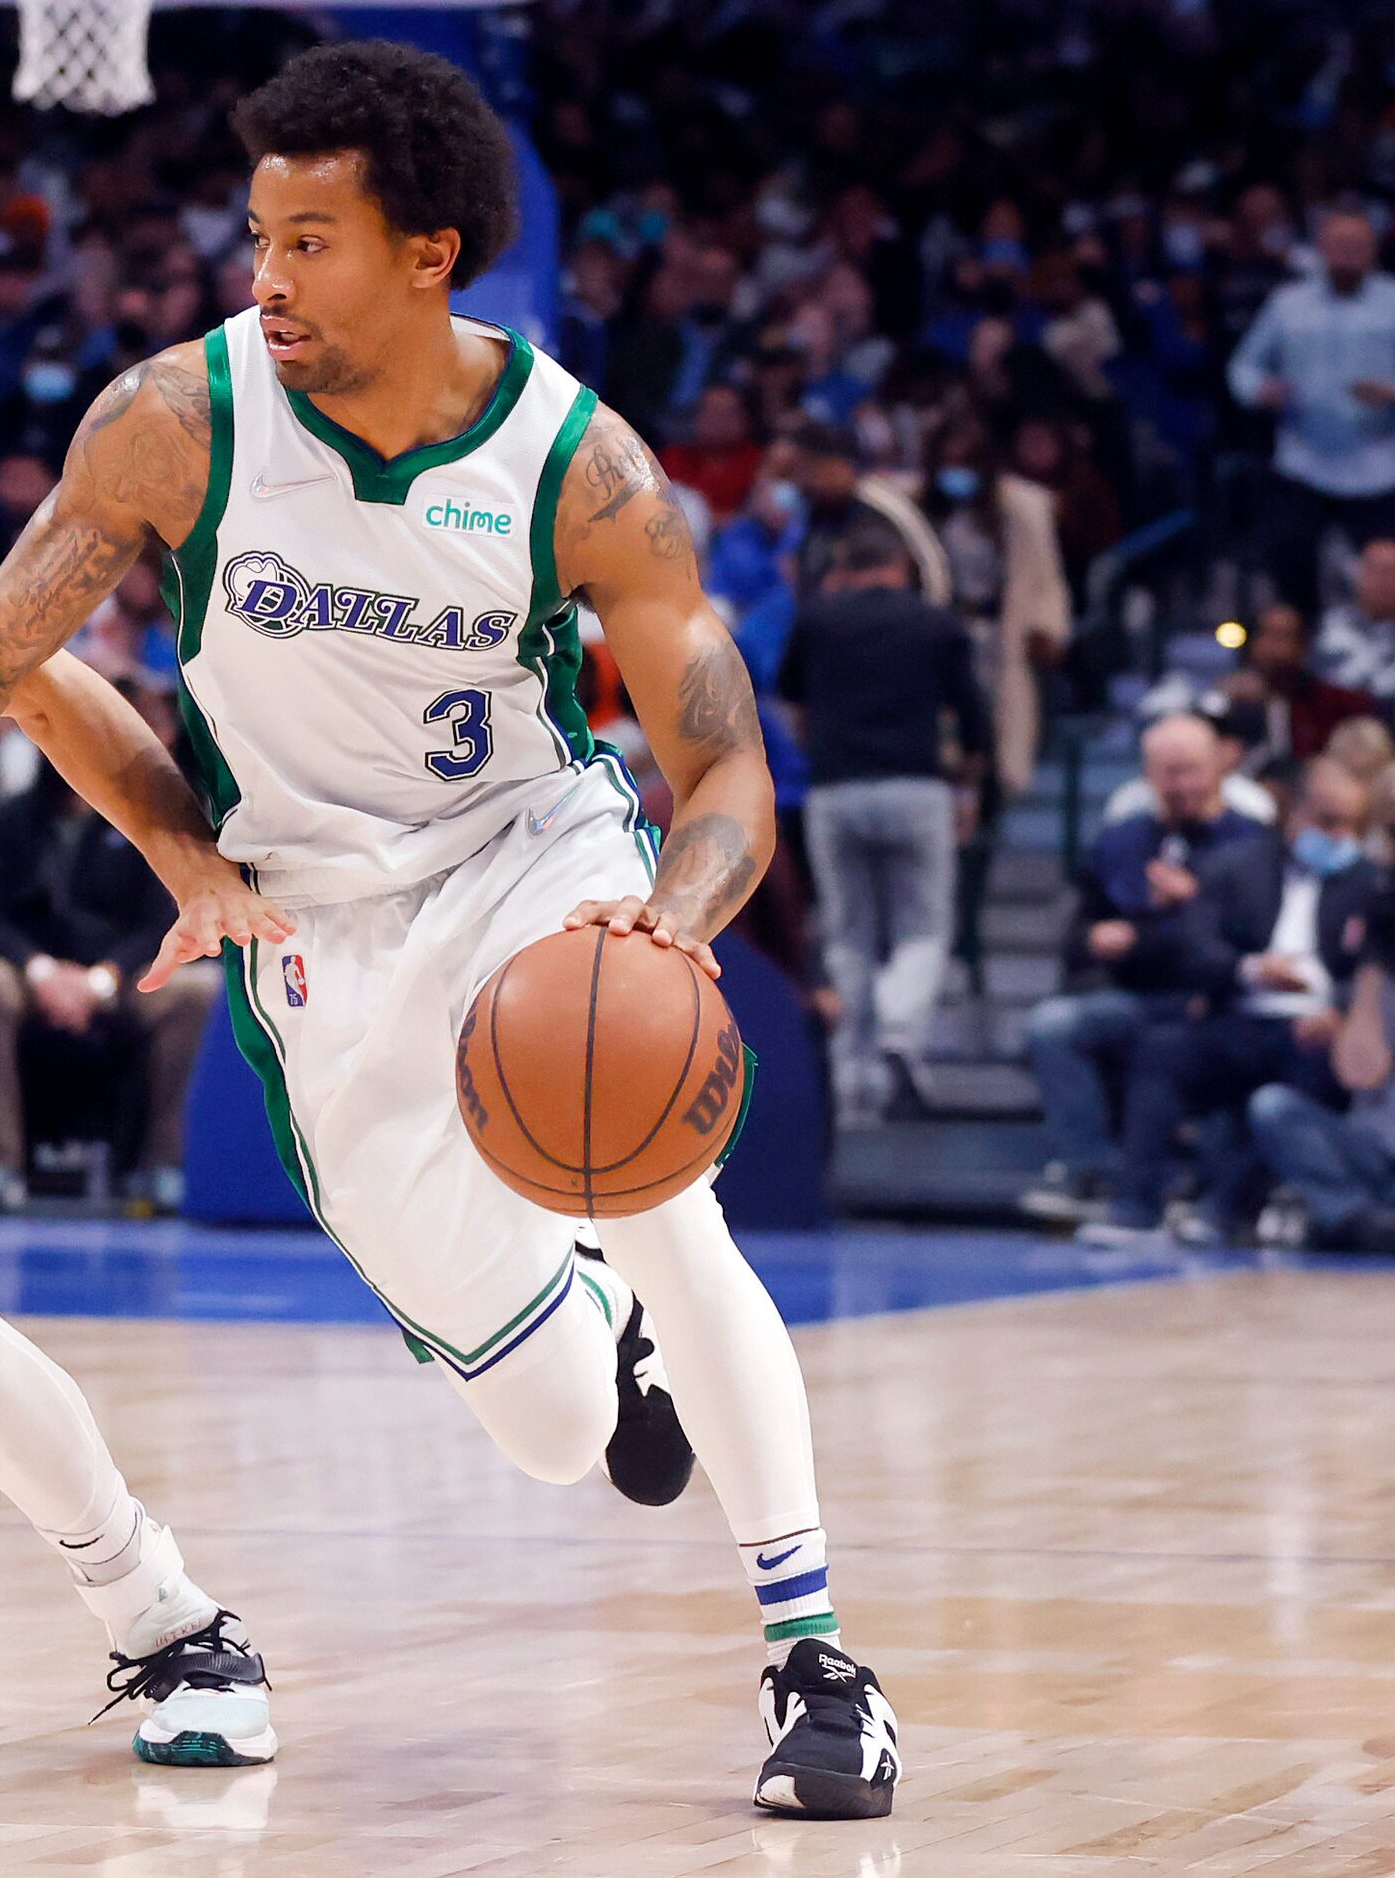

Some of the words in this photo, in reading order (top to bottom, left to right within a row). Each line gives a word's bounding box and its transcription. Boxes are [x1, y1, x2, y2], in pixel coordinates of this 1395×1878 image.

[425, 499, 512, 535] chime
[228, 575, 517, 651] DALLAS
[423, 688, 493, 781] 3
[289, 993, 299, 1005] 75
